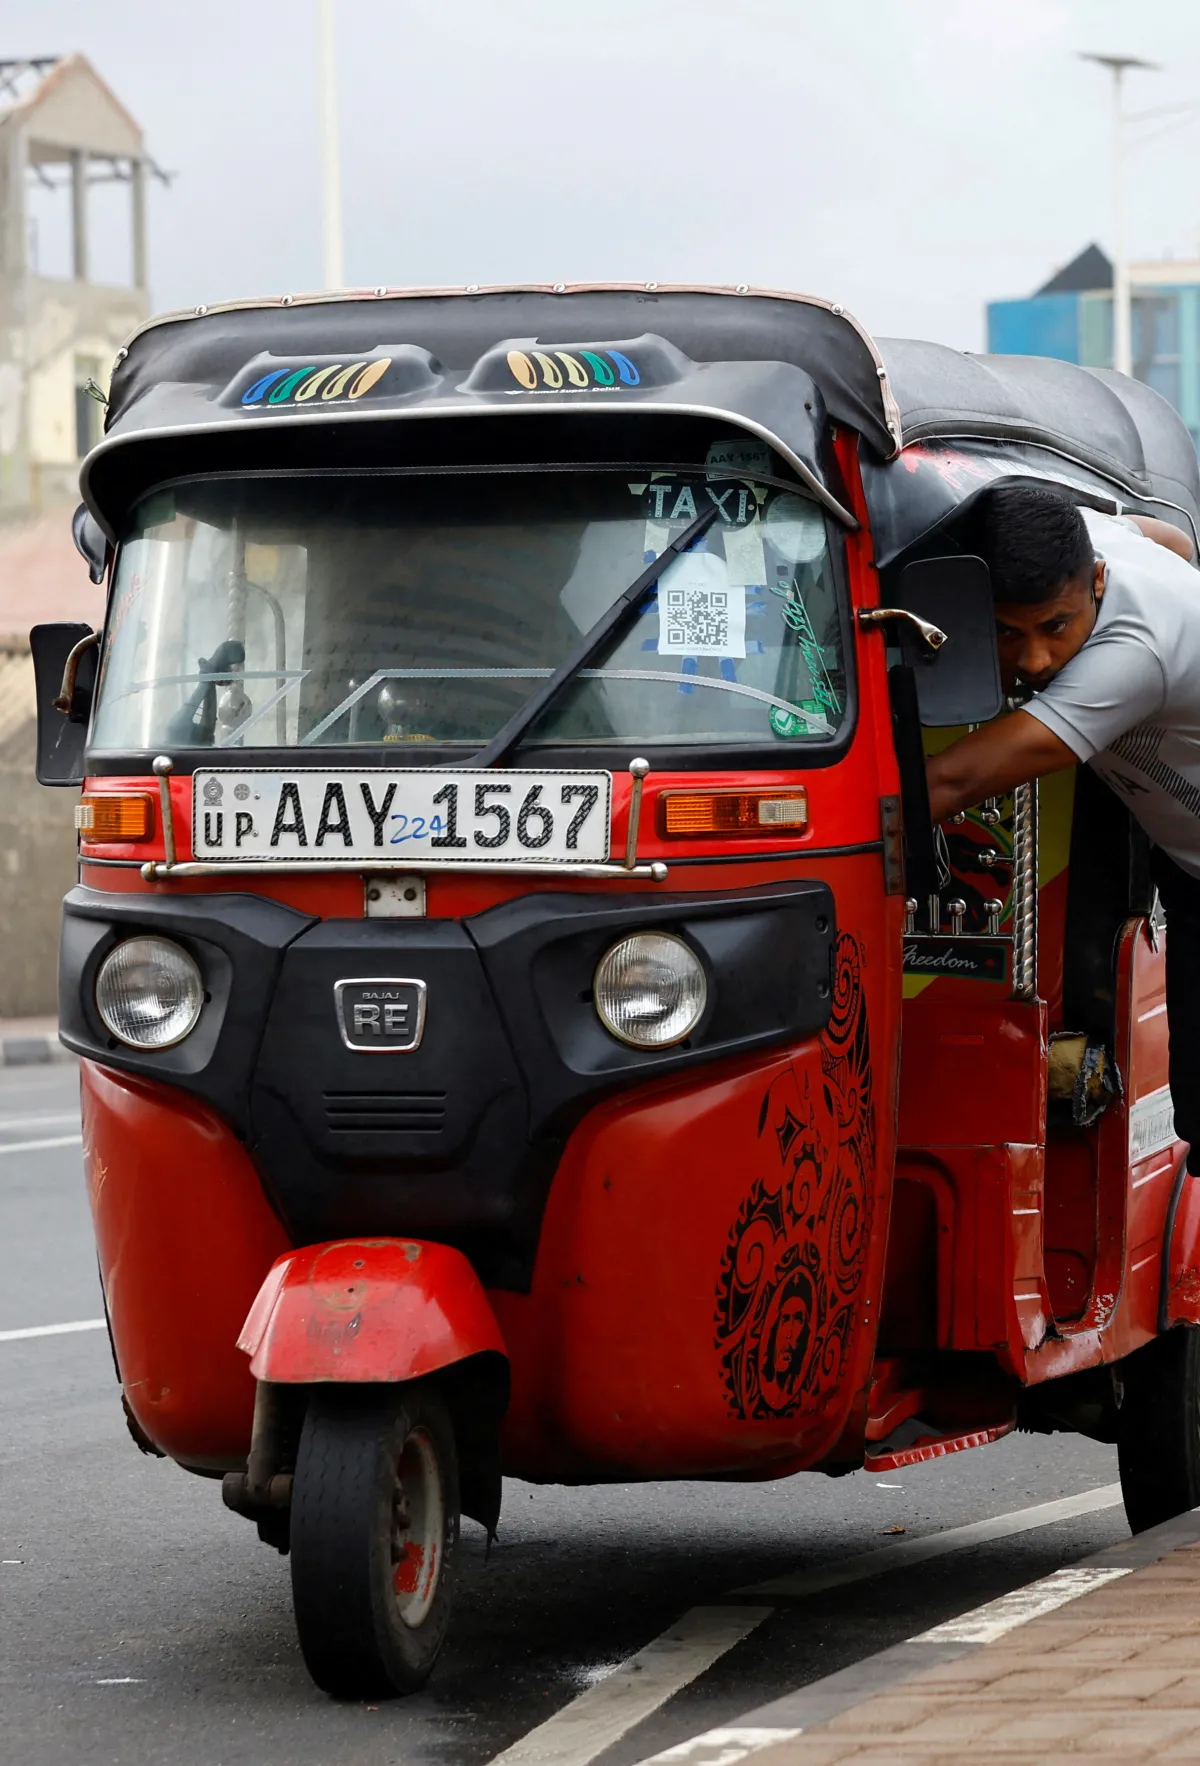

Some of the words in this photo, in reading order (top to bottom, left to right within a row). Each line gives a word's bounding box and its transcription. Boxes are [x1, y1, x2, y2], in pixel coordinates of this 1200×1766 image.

[649, 484, 749, 523] TAXI
[204, 811, 254, 847] UP
[270, 781, 399, 847] AAY
[430, 783, 600, 849] 1567
[390, 814, 448, 844] 224
[902, 944, 979, 969] Freedom
[362, 992, 400, 1000] BAJAJ
[353, 1003, 410, 1035] RE
